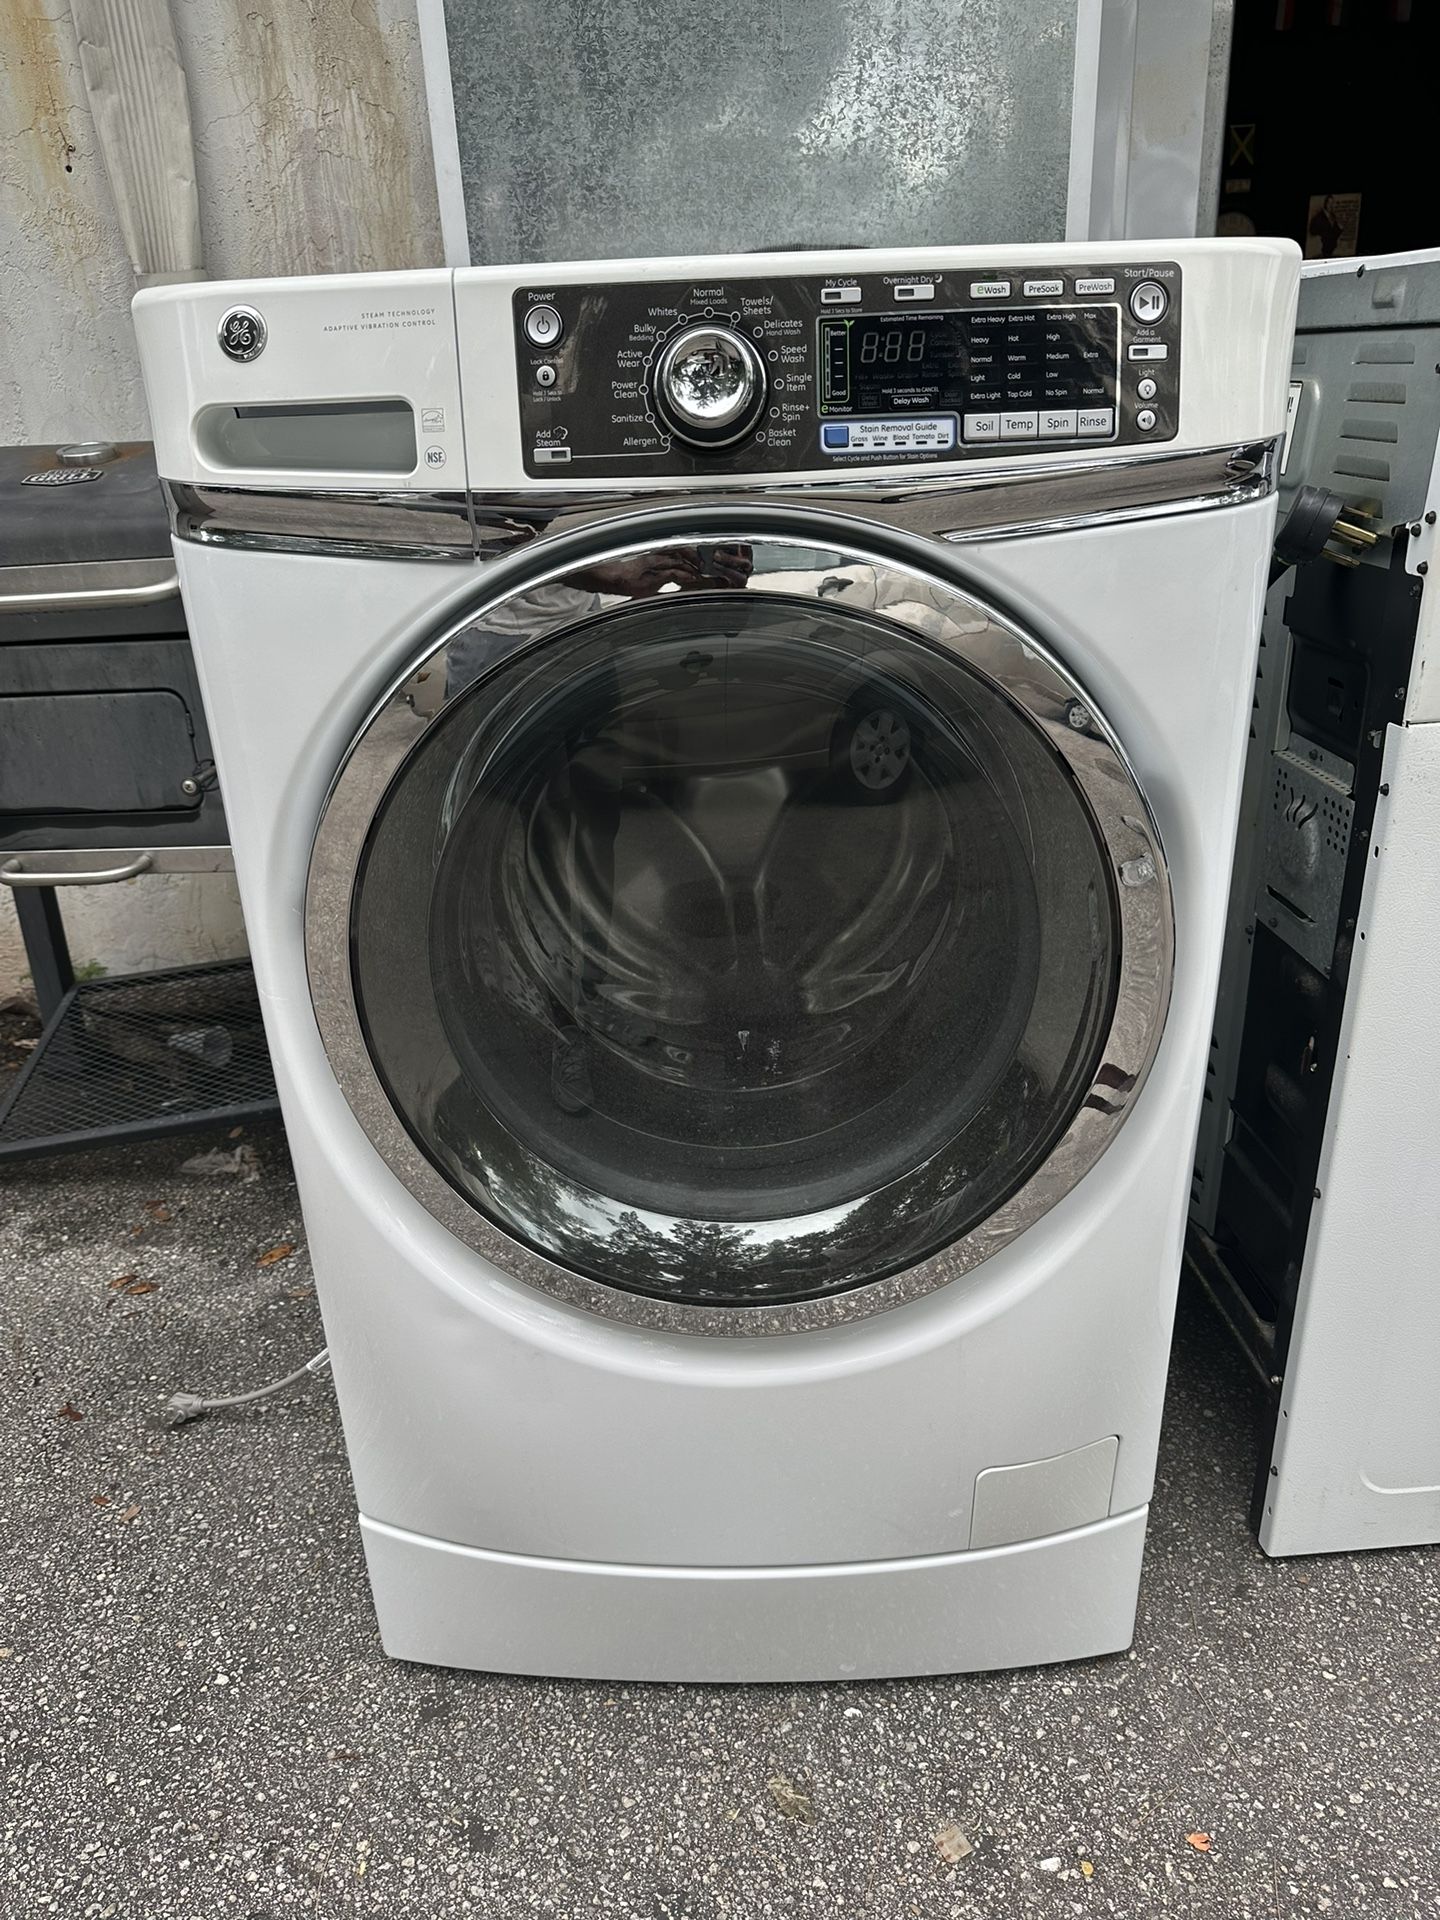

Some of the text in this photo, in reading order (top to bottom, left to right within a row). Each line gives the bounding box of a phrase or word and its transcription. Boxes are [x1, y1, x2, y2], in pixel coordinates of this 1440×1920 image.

[1124, 268, 1174, 278] Start/Pause
[825, 278, 857, 287] My Cycle
[883, 275, 934, 285] Overnight Dry
[1029, 285, 1060, 294] PreSoak
[1079, 282, 1112, 291] PreWash
[528, 292, 556, 301] Power
[693, 288, 724, 297] Normal
[740, 296, 774, 306] Towels/
[387, 308, 435, 317] TECHNOLOGY
[648, 308, 678, 316] Whites
[743, 307, 772, 316] Sheets
[987, 316, 1005, 324] Heavy
[1062, 313, 1077, 321] High
[323, 319, 436, 332] ADAPTIVE VIBRATION CONTROL
[634, 324, 656, 334] Bulky
[764, 320, 803, 329] Delicates
[629, 334, 654, 342] Bedding
[1046, 333, 1060, 341] High
[617, 349, 643, 358] Active
[781, 344, 807, 355] Speed
[781, 355, 805, 363] Wash
[1046, 352, 1070, 360] Medium
[617, 360, 640, 368] Wear
[1007, 372, 1021, 380] Cold
[1139, 369, 1155, 377] Light
[786, 373, 813, 384] Single
[971, 374, 986, 382] Light
[611, 381, 638, 389] Power
[786, 383, 806, 392] Item
[614, 391, 638, 399] Clean
[1007, 391, 1018, 399] Tap
[1054, 389, 1068, 397] Spin
[1083, 387, 1105, 395] Normal
[985, 392, 1001, 400] Light
[893, 398, 911, 406] Delay
[1134, 402, 1159, 410] Volume
[782, 403, 810, 412] Rinse+
[611, 414, 644, 423] Sanitize
[782, 412, 801, 422] Spin
[976, 421, 994, 431] Soil
[1006, 419, 1033, 431] Temp
[1047, 417, 1069, 430] Spin
[1080, 417, 1106, 427] Rinse
[860, 422, 938, 433] Stain Removal Guide
[536, 430, 551, 438] Add
[768, 428, 797, 437] Basket
[536, 439, 561, 447] Steam
[623, 437, 657, 447] Allergen
[767, 438, 791, 447] Clean
[427, 452, 443, 463] NSF
[847, 455, 860, 463] Cycle
